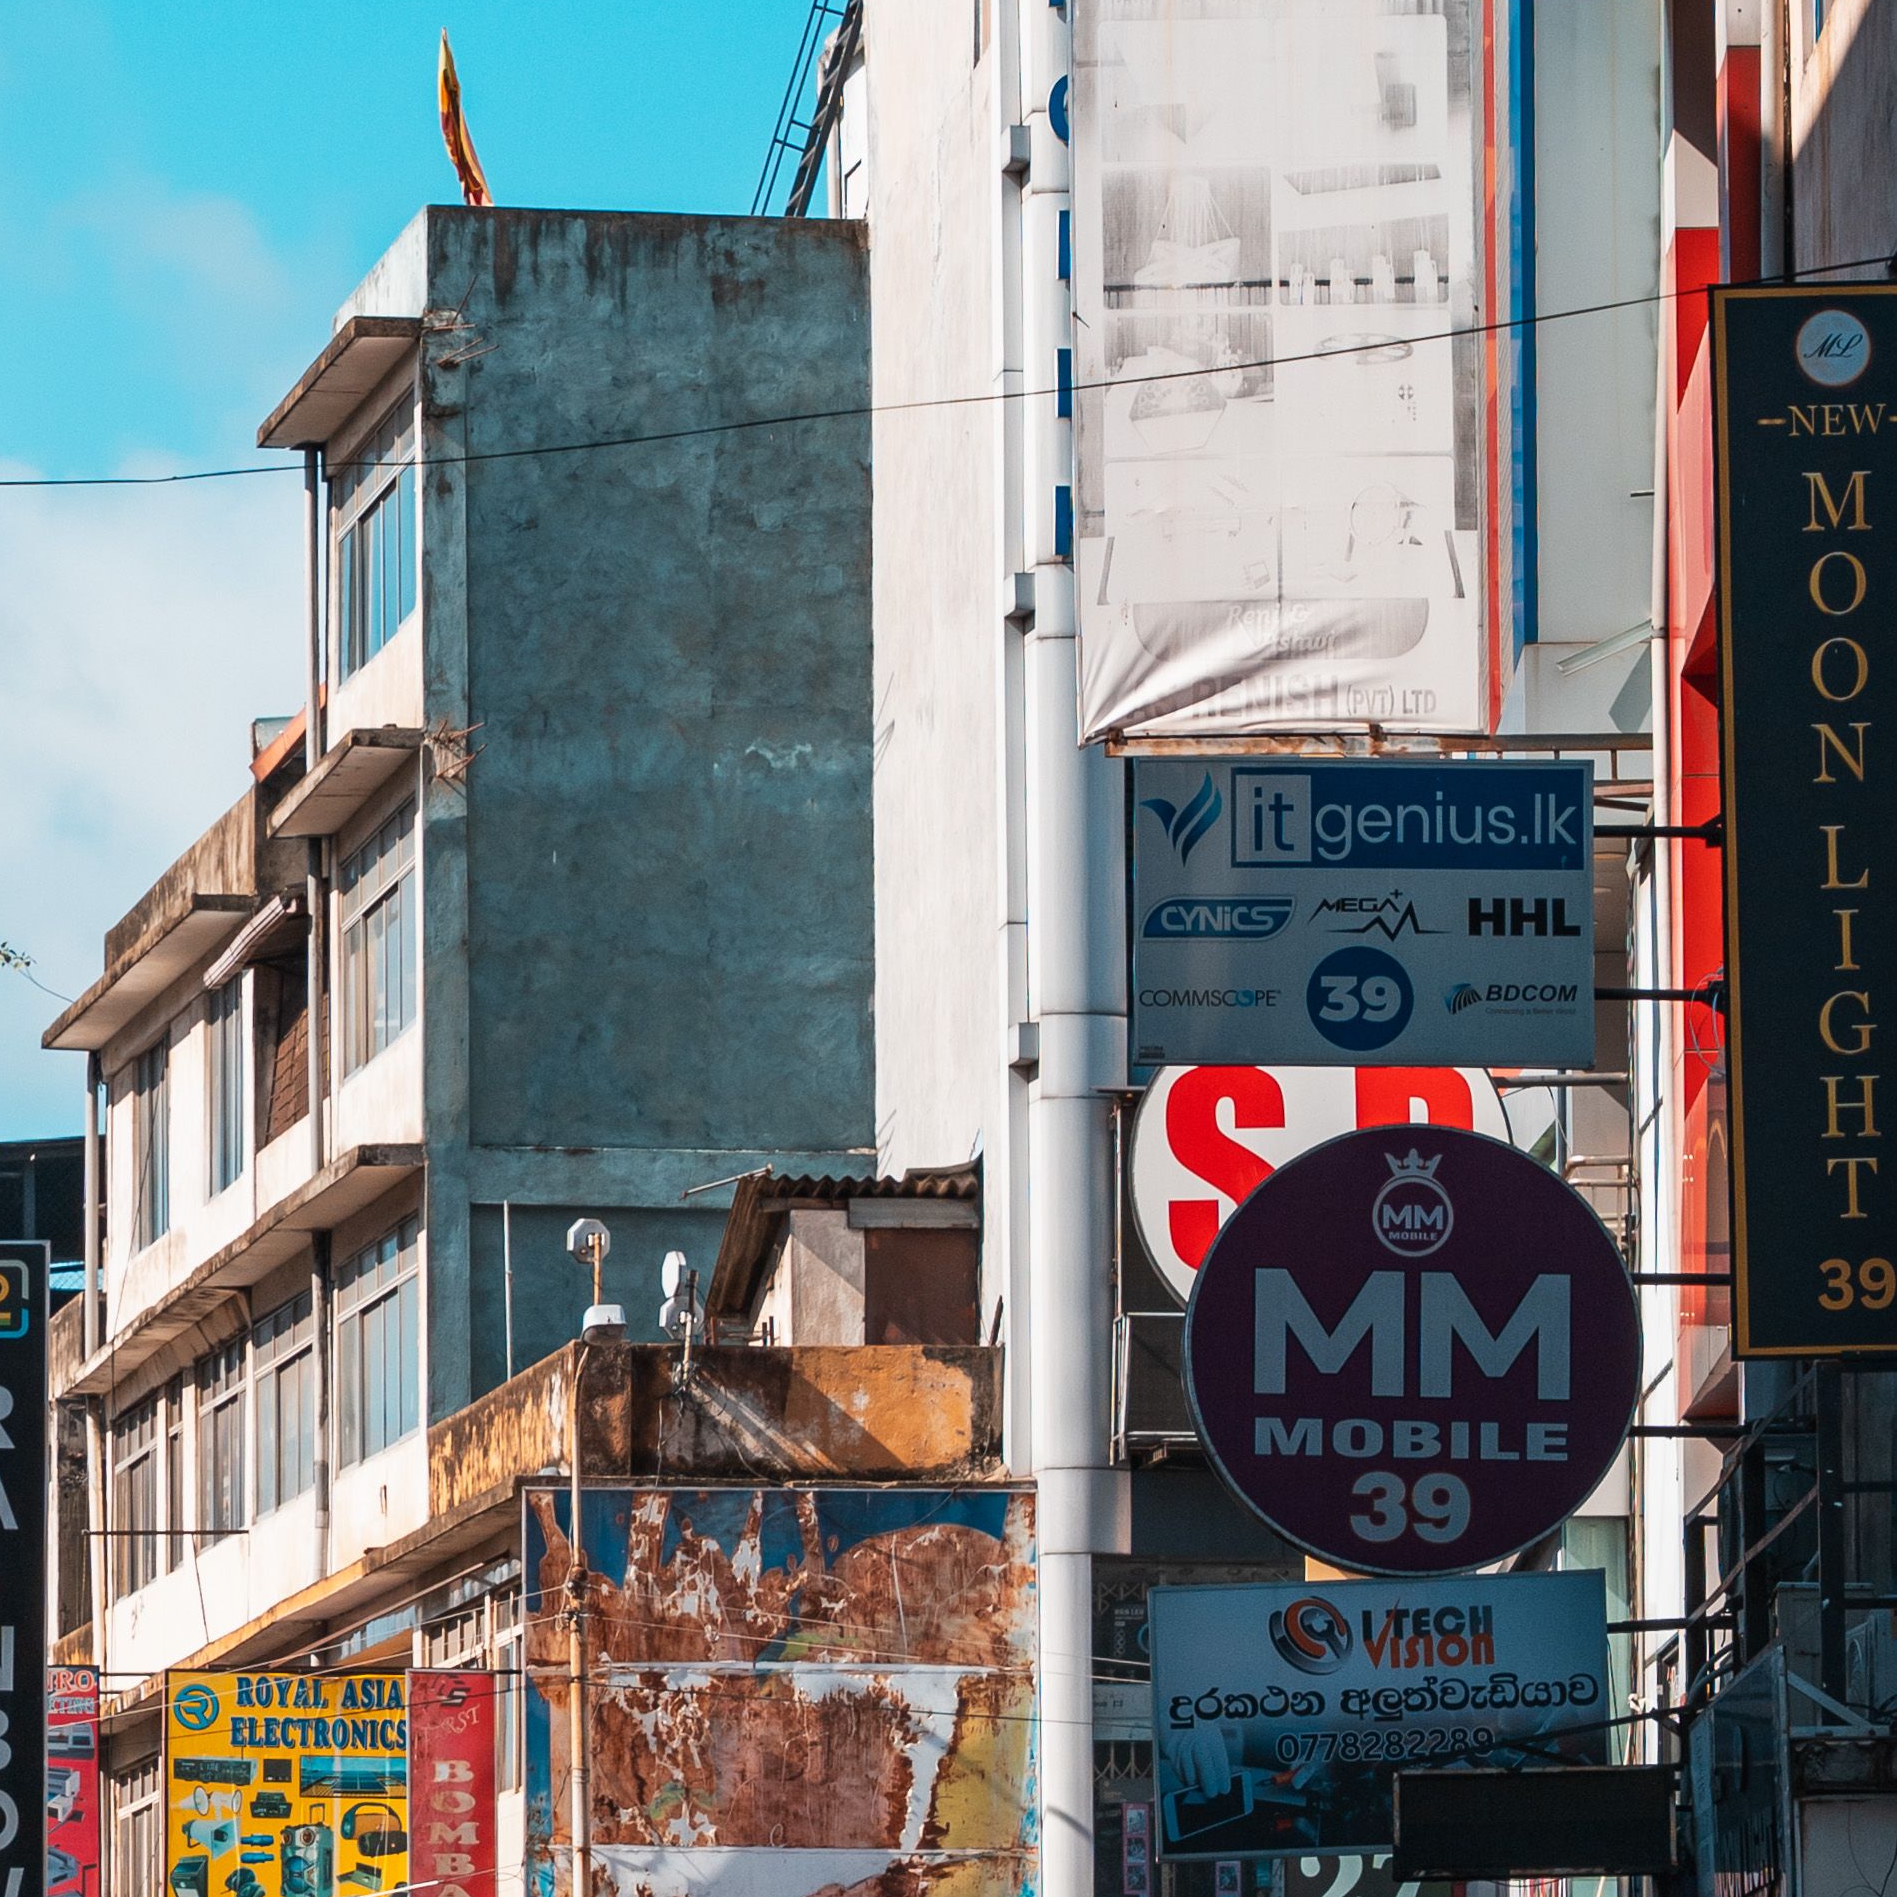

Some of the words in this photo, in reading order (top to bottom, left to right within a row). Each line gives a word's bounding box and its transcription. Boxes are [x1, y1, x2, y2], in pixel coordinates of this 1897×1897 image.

[1787, 403, 1887, 436] NEW
[1801, 469, 1873, 785] MOON
[1346, 685, 1395, 716] (PVT)
[1402, 689, 1437, 715] LTD
[1467, 897, 1581, 937] HHL
[1319, 974, 1403, 1023] 39
[1485, 984, 1578, 1003] BDCOM
[1817, 825, 1881, 1221] LIGHT
[1382, 1203, 1443, 1229] MM
[1388, 1231, 1438, 1241] MOBILE
[1254, 1266, 1572, 1401] MM
[1254, 1416, 1569, 1461] MOBILE
[1349, 1470, 1471, 1543] 39
[236, 1675, 328, 1708] ROYAL
[341, 1676, 405, 1709] ASIA
[230, 1716, 407, 1751] ELECTRONICS
[1276, 1728, 1496, 1763] 0778282289
